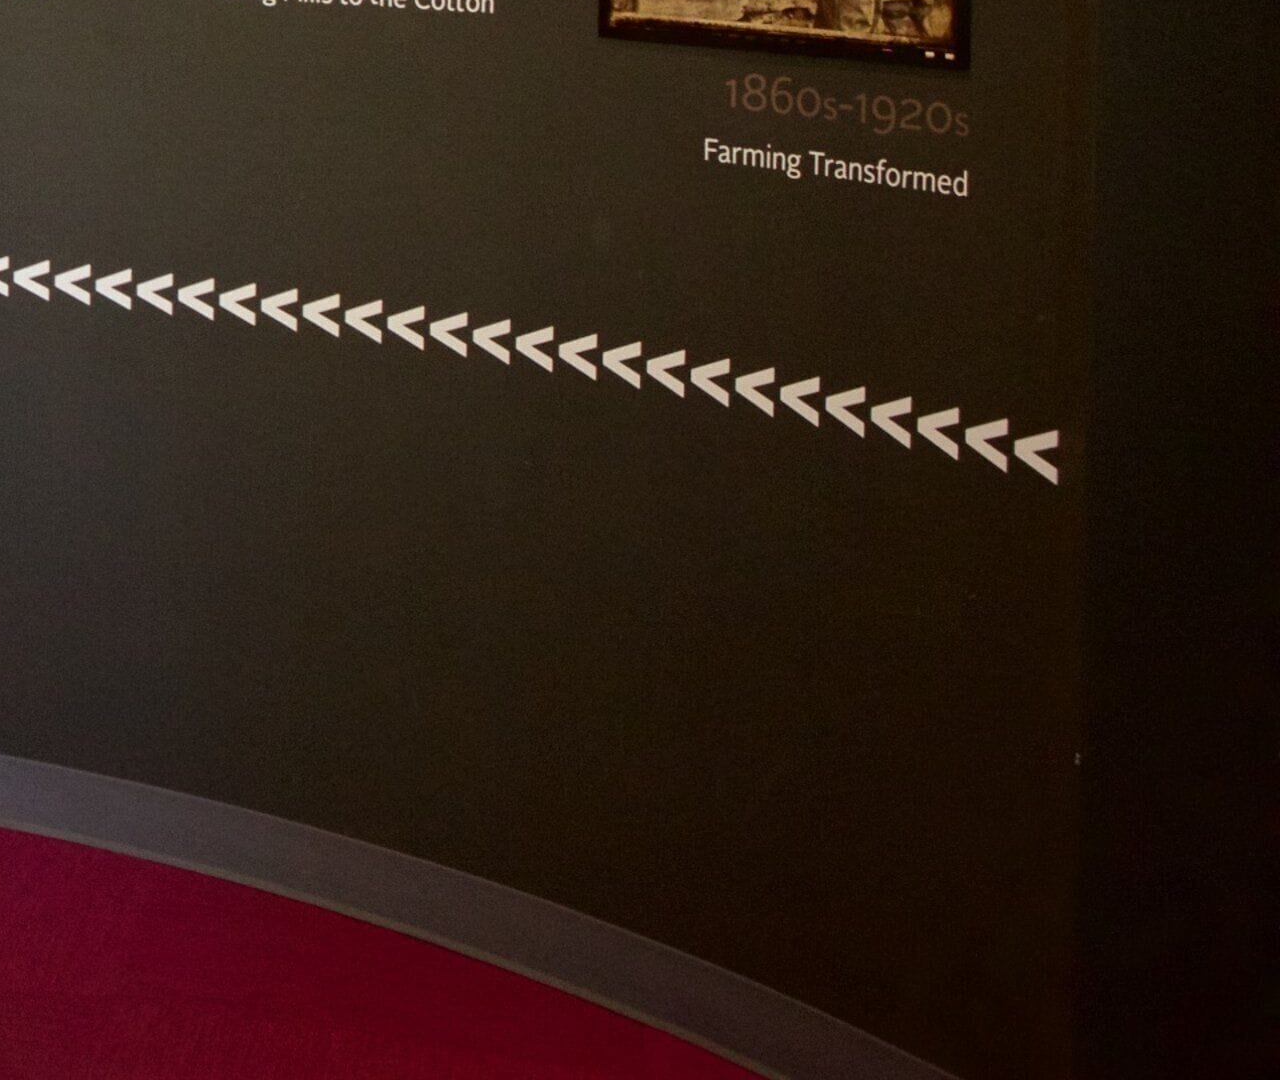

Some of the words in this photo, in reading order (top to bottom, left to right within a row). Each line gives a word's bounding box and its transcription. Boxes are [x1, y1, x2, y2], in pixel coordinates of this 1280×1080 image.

[725, 73, 968, 136] 1860s-1920s
[704, 138, 801, 179] Farming
[809, 151, 968, 196] Transformed
